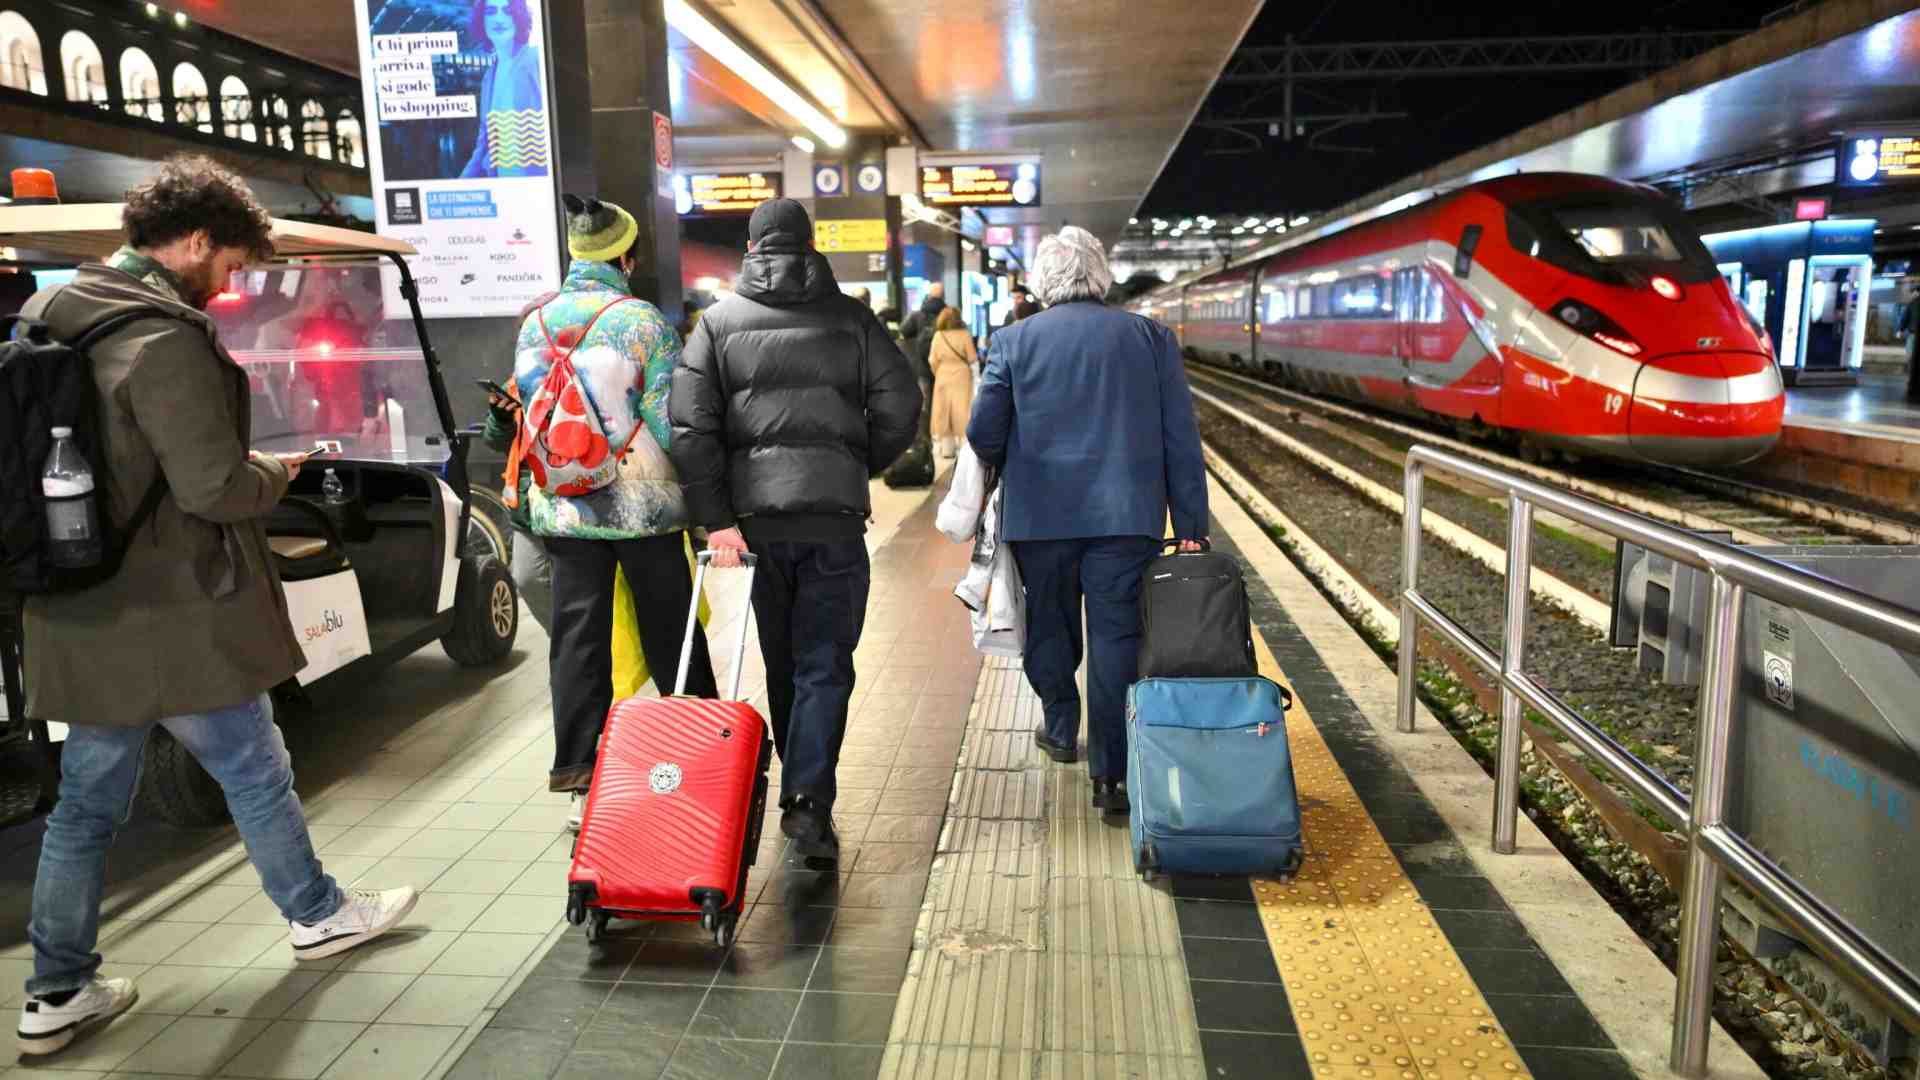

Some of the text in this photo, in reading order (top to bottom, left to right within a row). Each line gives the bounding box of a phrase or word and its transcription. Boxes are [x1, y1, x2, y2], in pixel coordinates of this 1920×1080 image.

[377, 35, 453, 54] Chi prima
[382, 79, 431, 94] si gode
[384, 101, 397, 113] lo
[1604, 392, 1624, 415] 19
